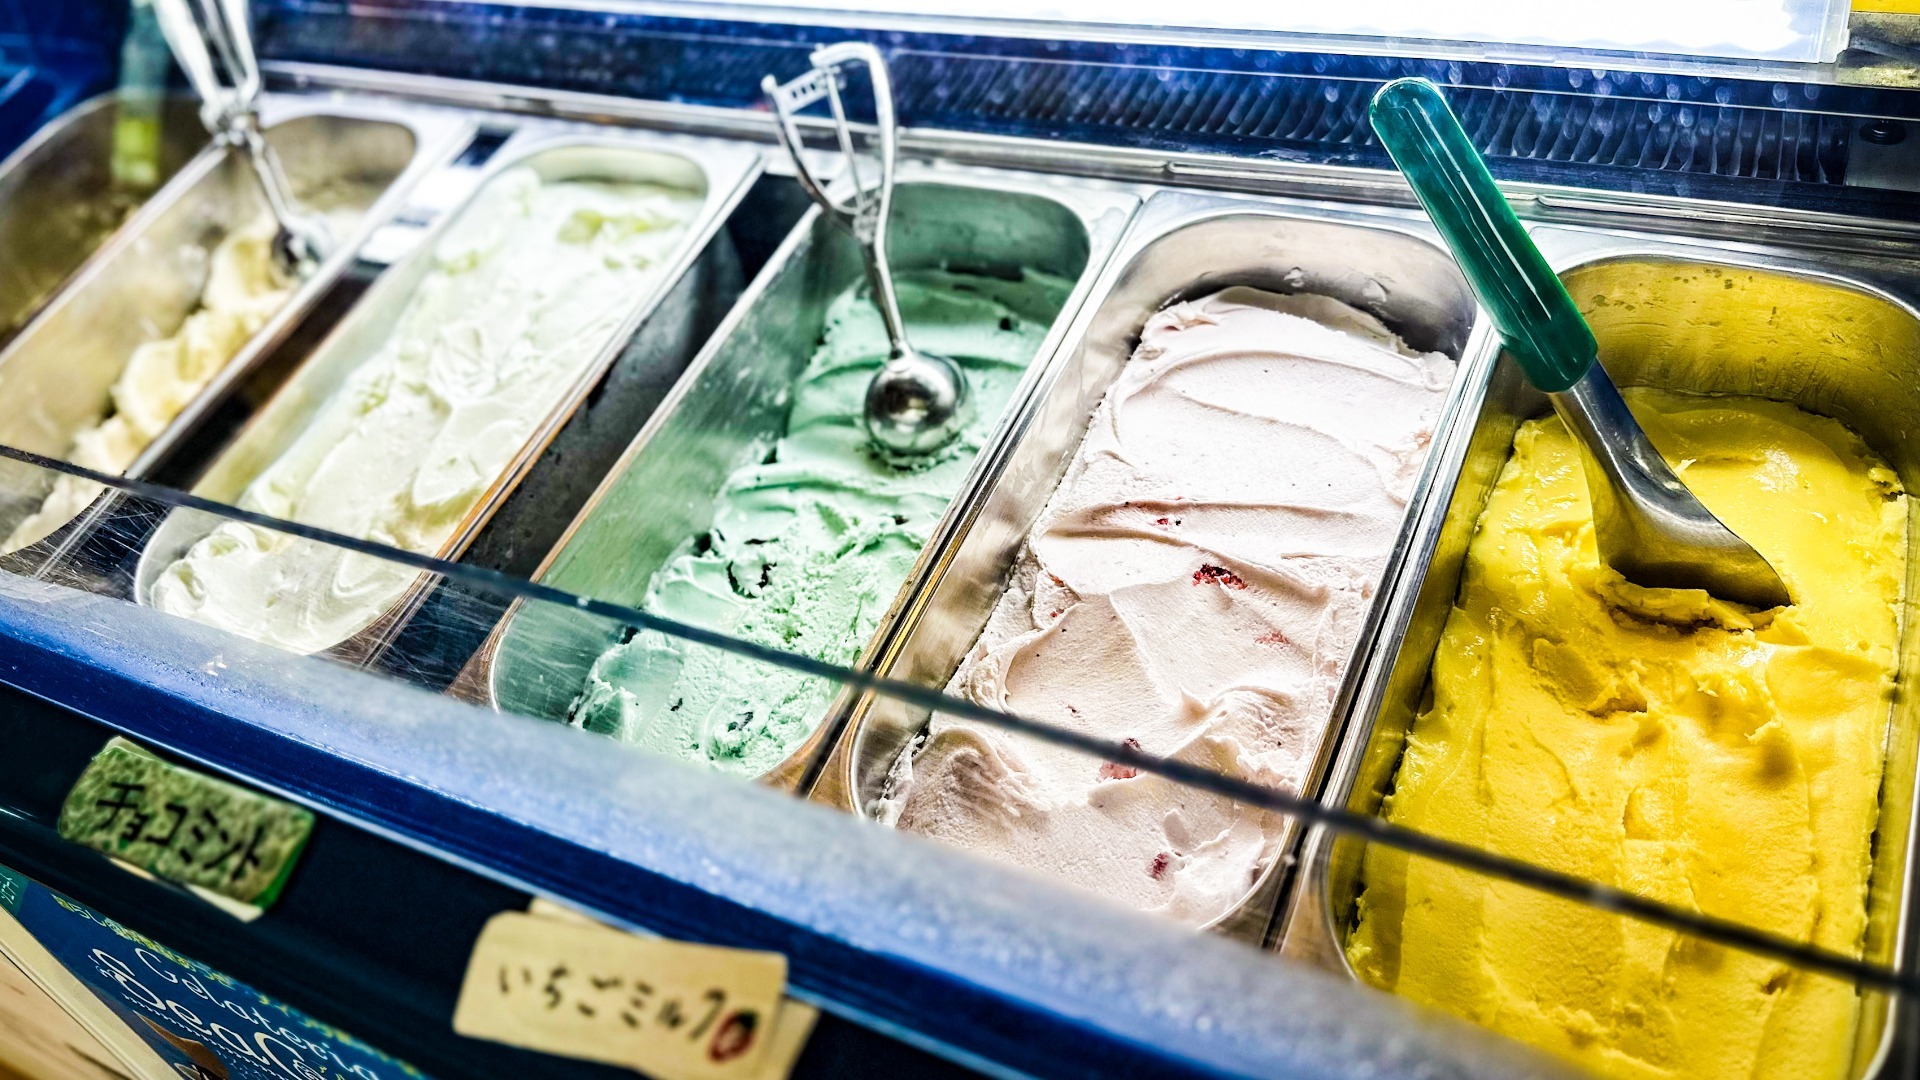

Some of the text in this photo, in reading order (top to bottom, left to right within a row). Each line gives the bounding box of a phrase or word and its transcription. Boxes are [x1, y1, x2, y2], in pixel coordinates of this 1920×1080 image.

[95, 780, 265, 882] チョコミント
[134, 947, 380, 1080] Gelateria
